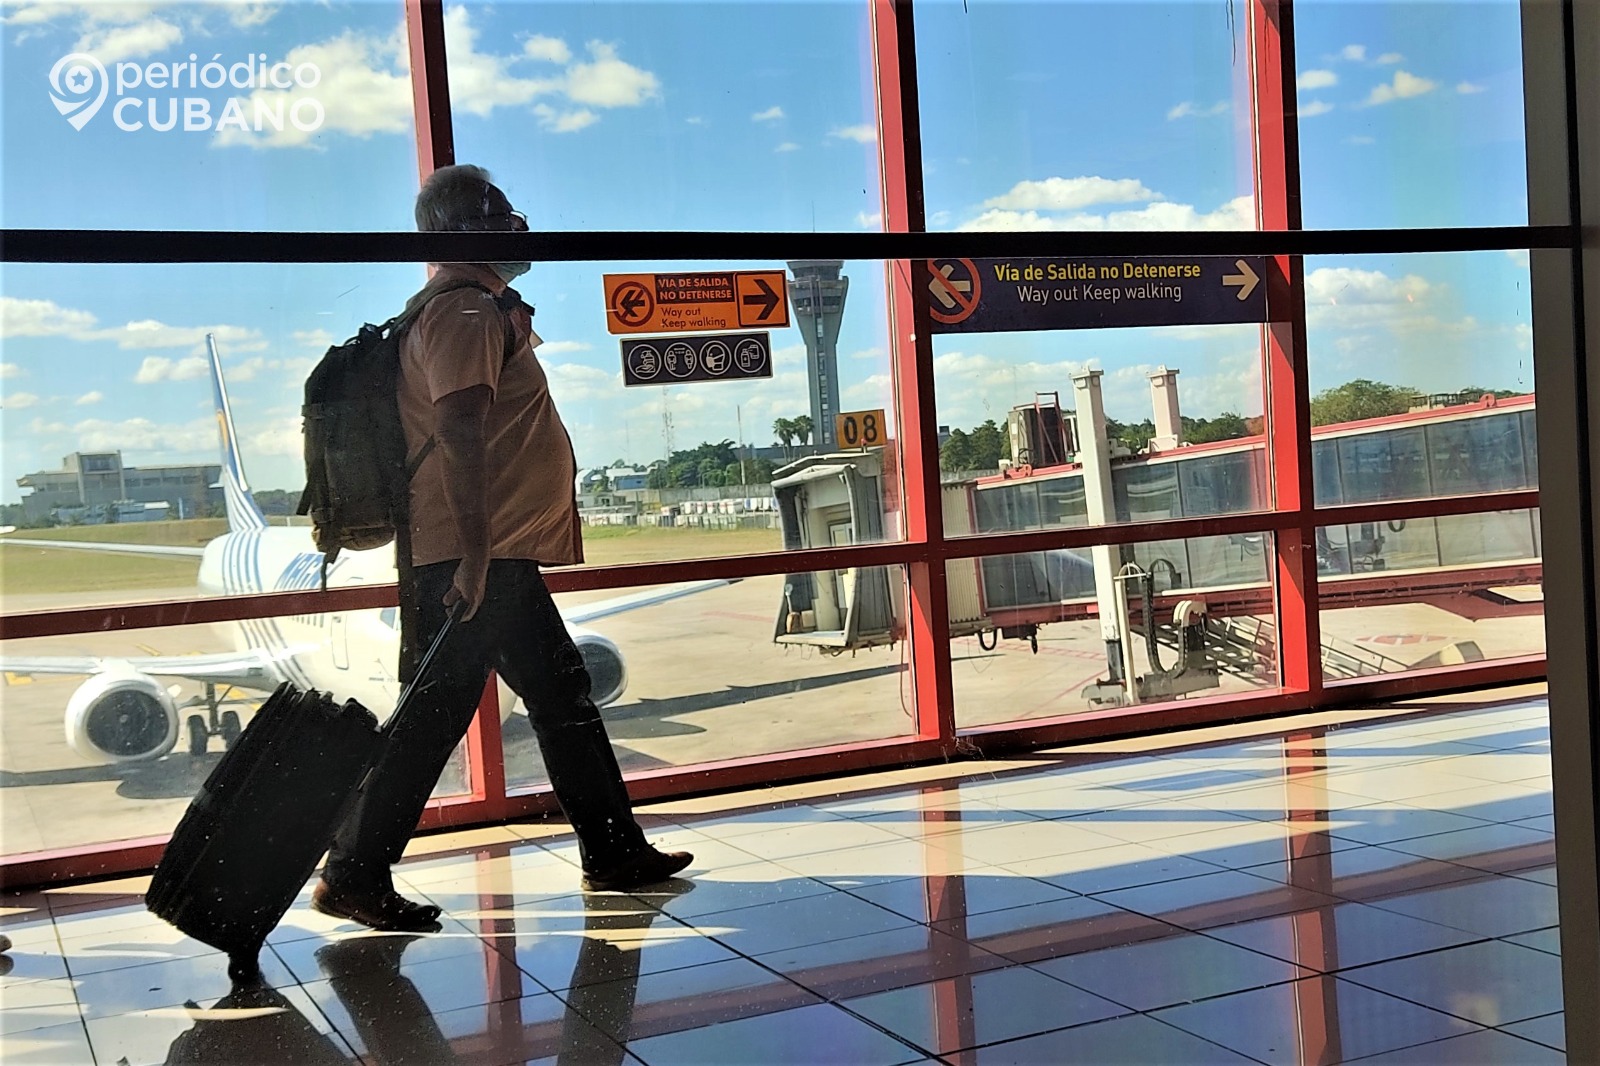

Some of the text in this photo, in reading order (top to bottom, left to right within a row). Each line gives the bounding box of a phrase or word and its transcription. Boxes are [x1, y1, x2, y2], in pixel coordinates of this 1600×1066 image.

[994, 262, 1200, 281] Vía de Salida no Detenerse
[658, 277, 729, 288] VIA DE SALIDA
[660, 290, 732, 300] NO DETENERSE
[1017, 282, 1182, 306] Way out Keep walking
[661, 307, 701, 319] Way out
[661, 316, 726, 329] Keep walking
[843, 414, 877, 445] 08
